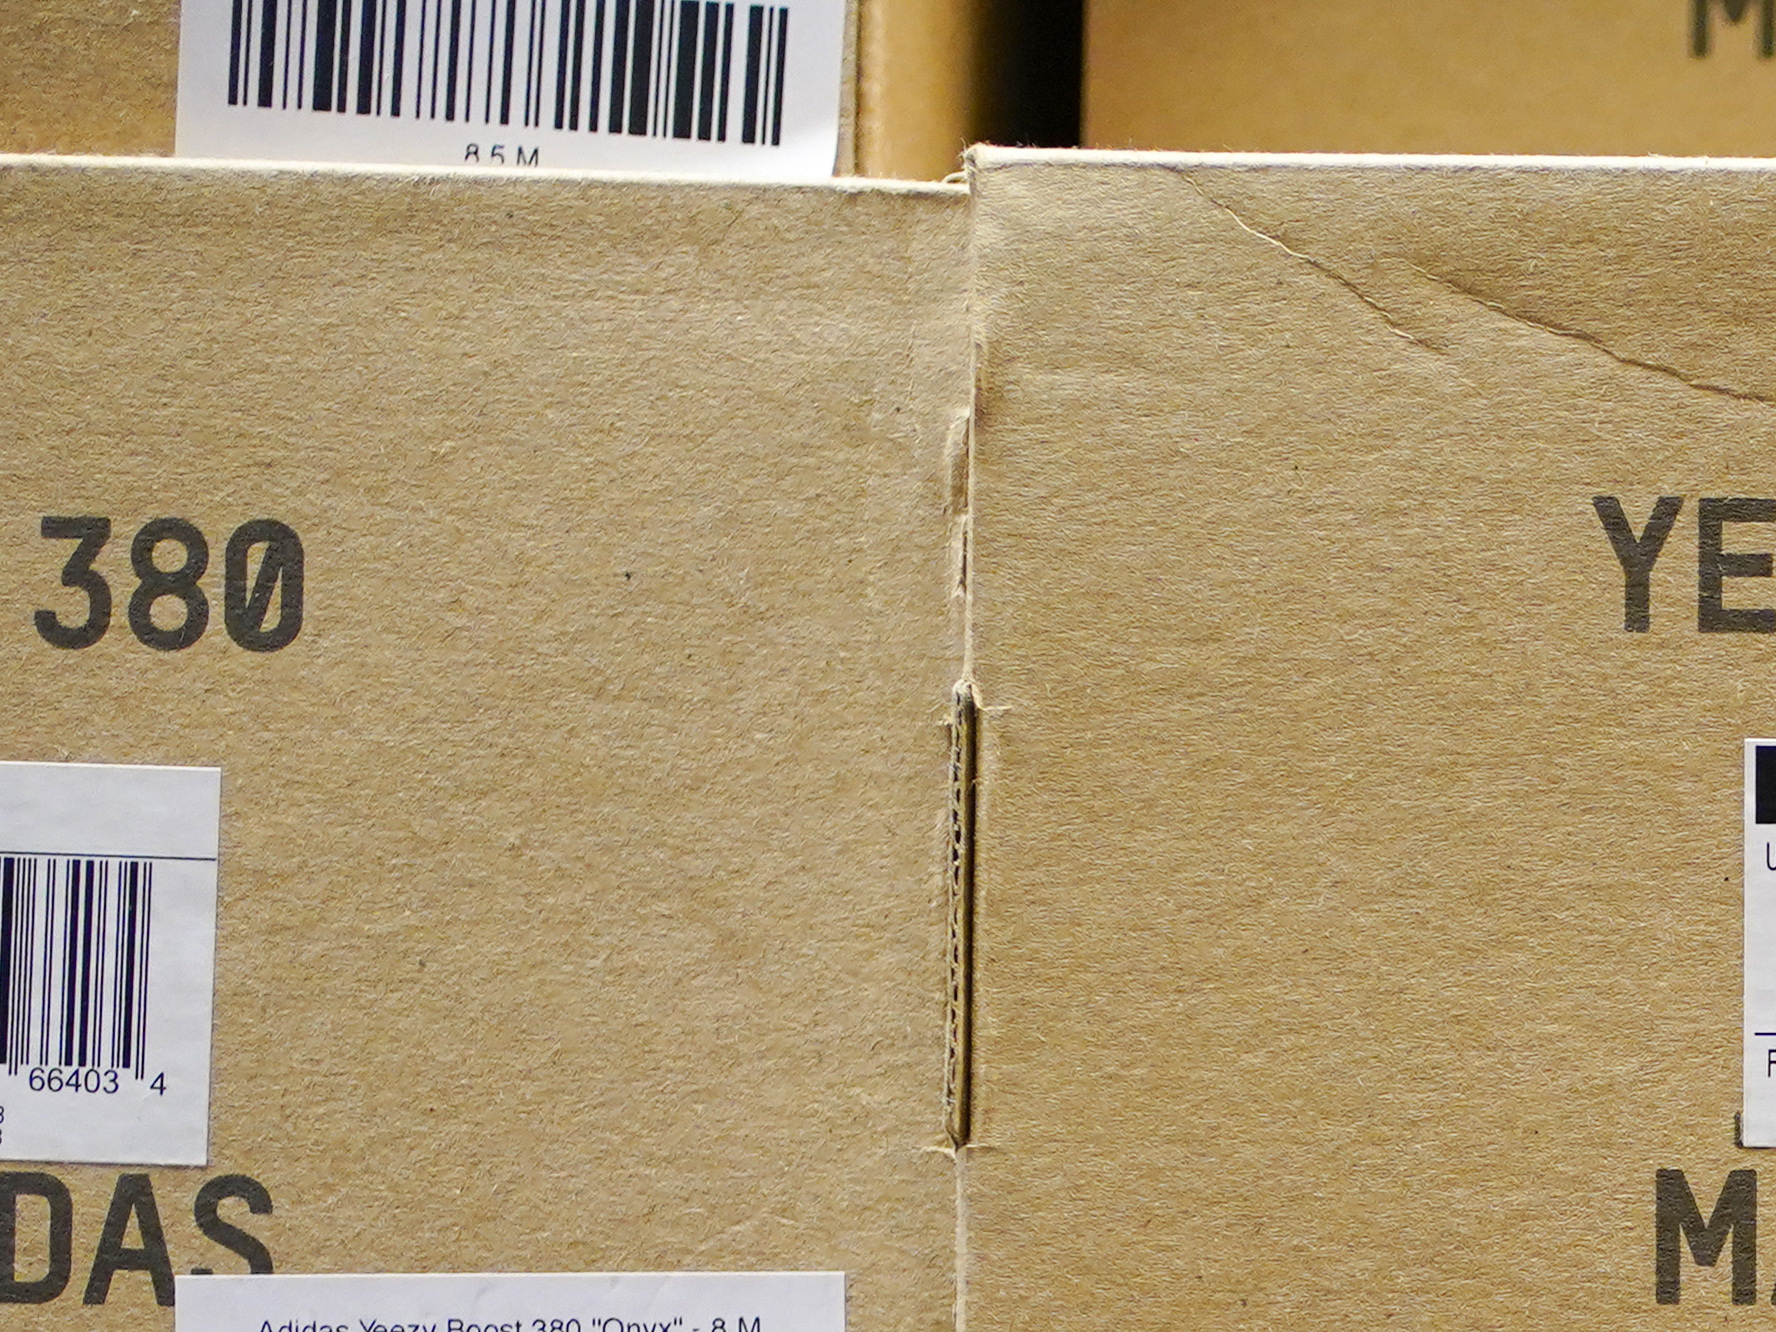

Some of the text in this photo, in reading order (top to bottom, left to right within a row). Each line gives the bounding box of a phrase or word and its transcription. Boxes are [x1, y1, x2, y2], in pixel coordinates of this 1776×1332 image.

[517, 146, 538, 165] M
[34, 516, 304, 652] 380
[29, 1065, 166, 1095] 66403 4
